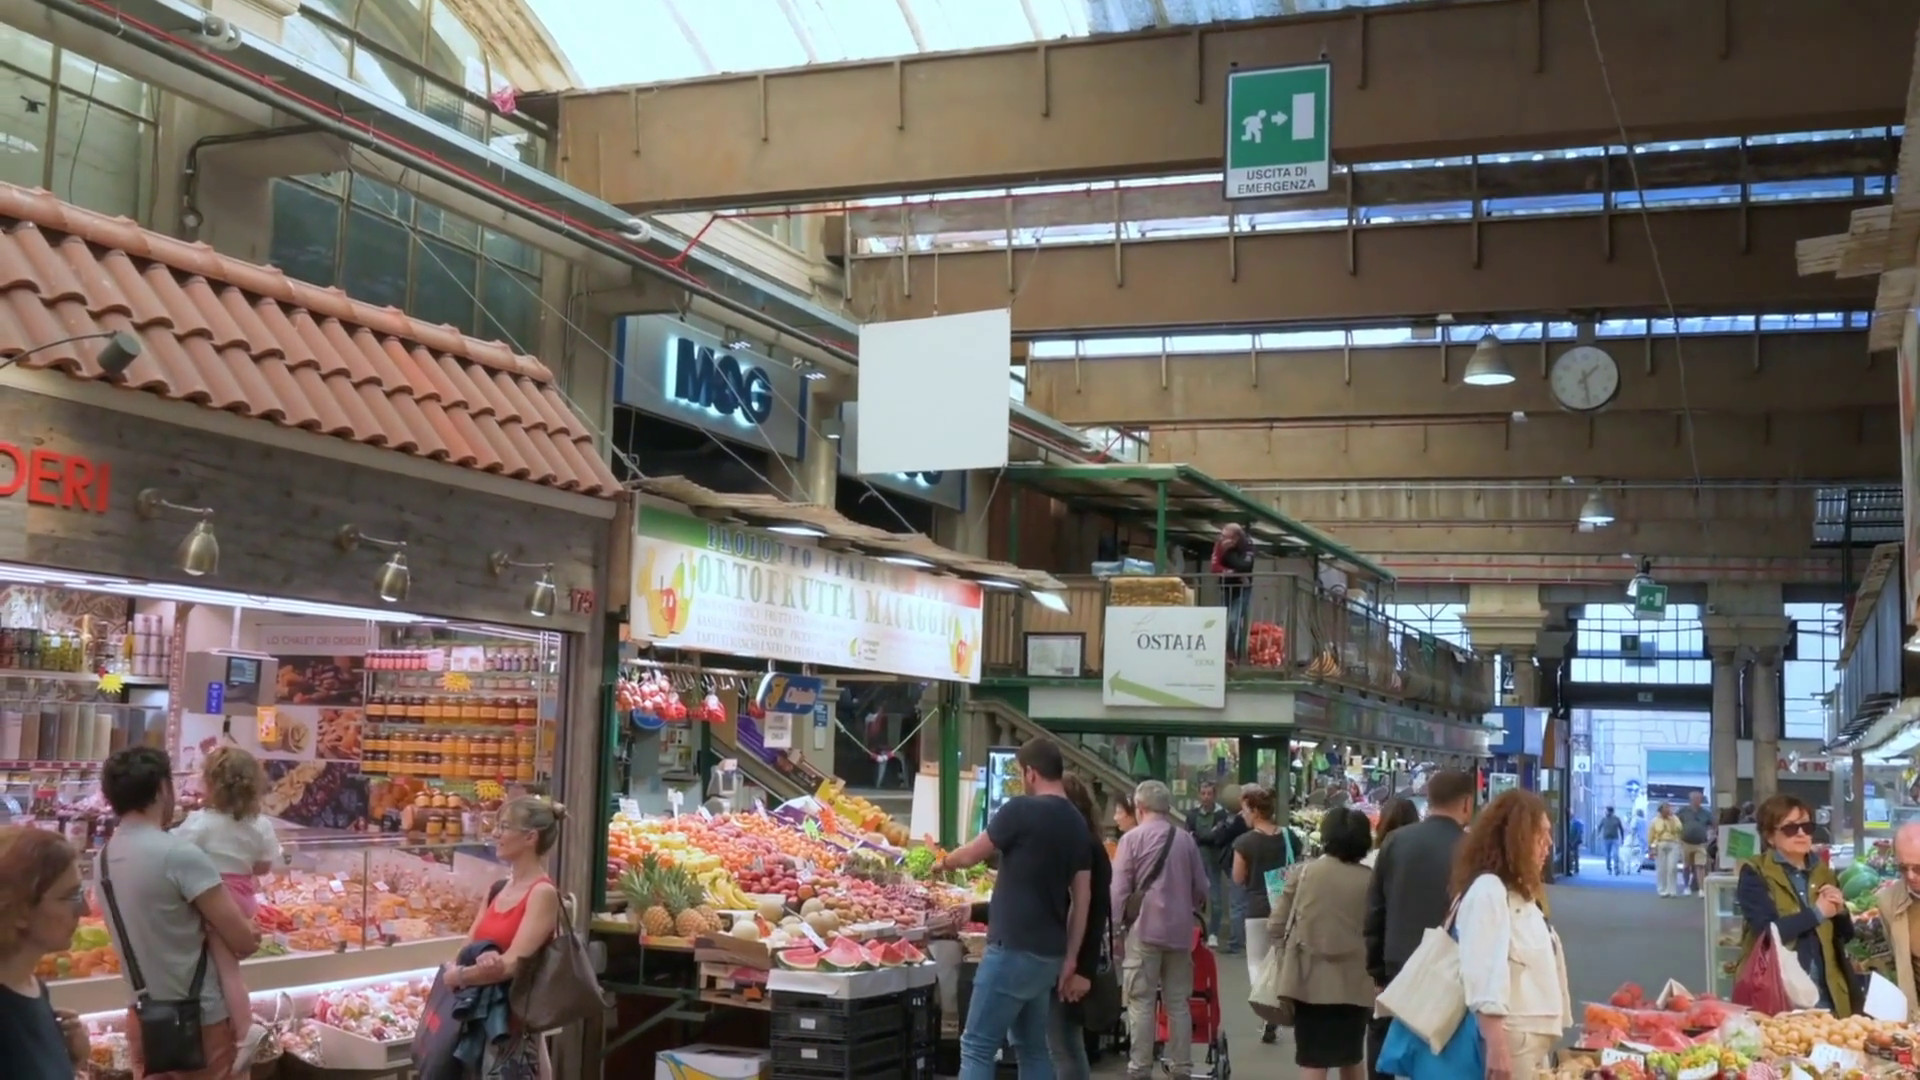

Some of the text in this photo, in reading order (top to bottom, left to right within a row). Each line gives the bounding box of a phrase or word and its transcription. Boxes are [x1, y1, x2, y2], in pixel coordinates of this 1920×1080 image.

[1246, 165, 1308, 181] USCITA DI
[1237, 179, 1316, 194] EMERGENZA
[697, 554, 857, 621] ORTOFRUTTA
[1136, 633, 1207, 651] OSTAIA
